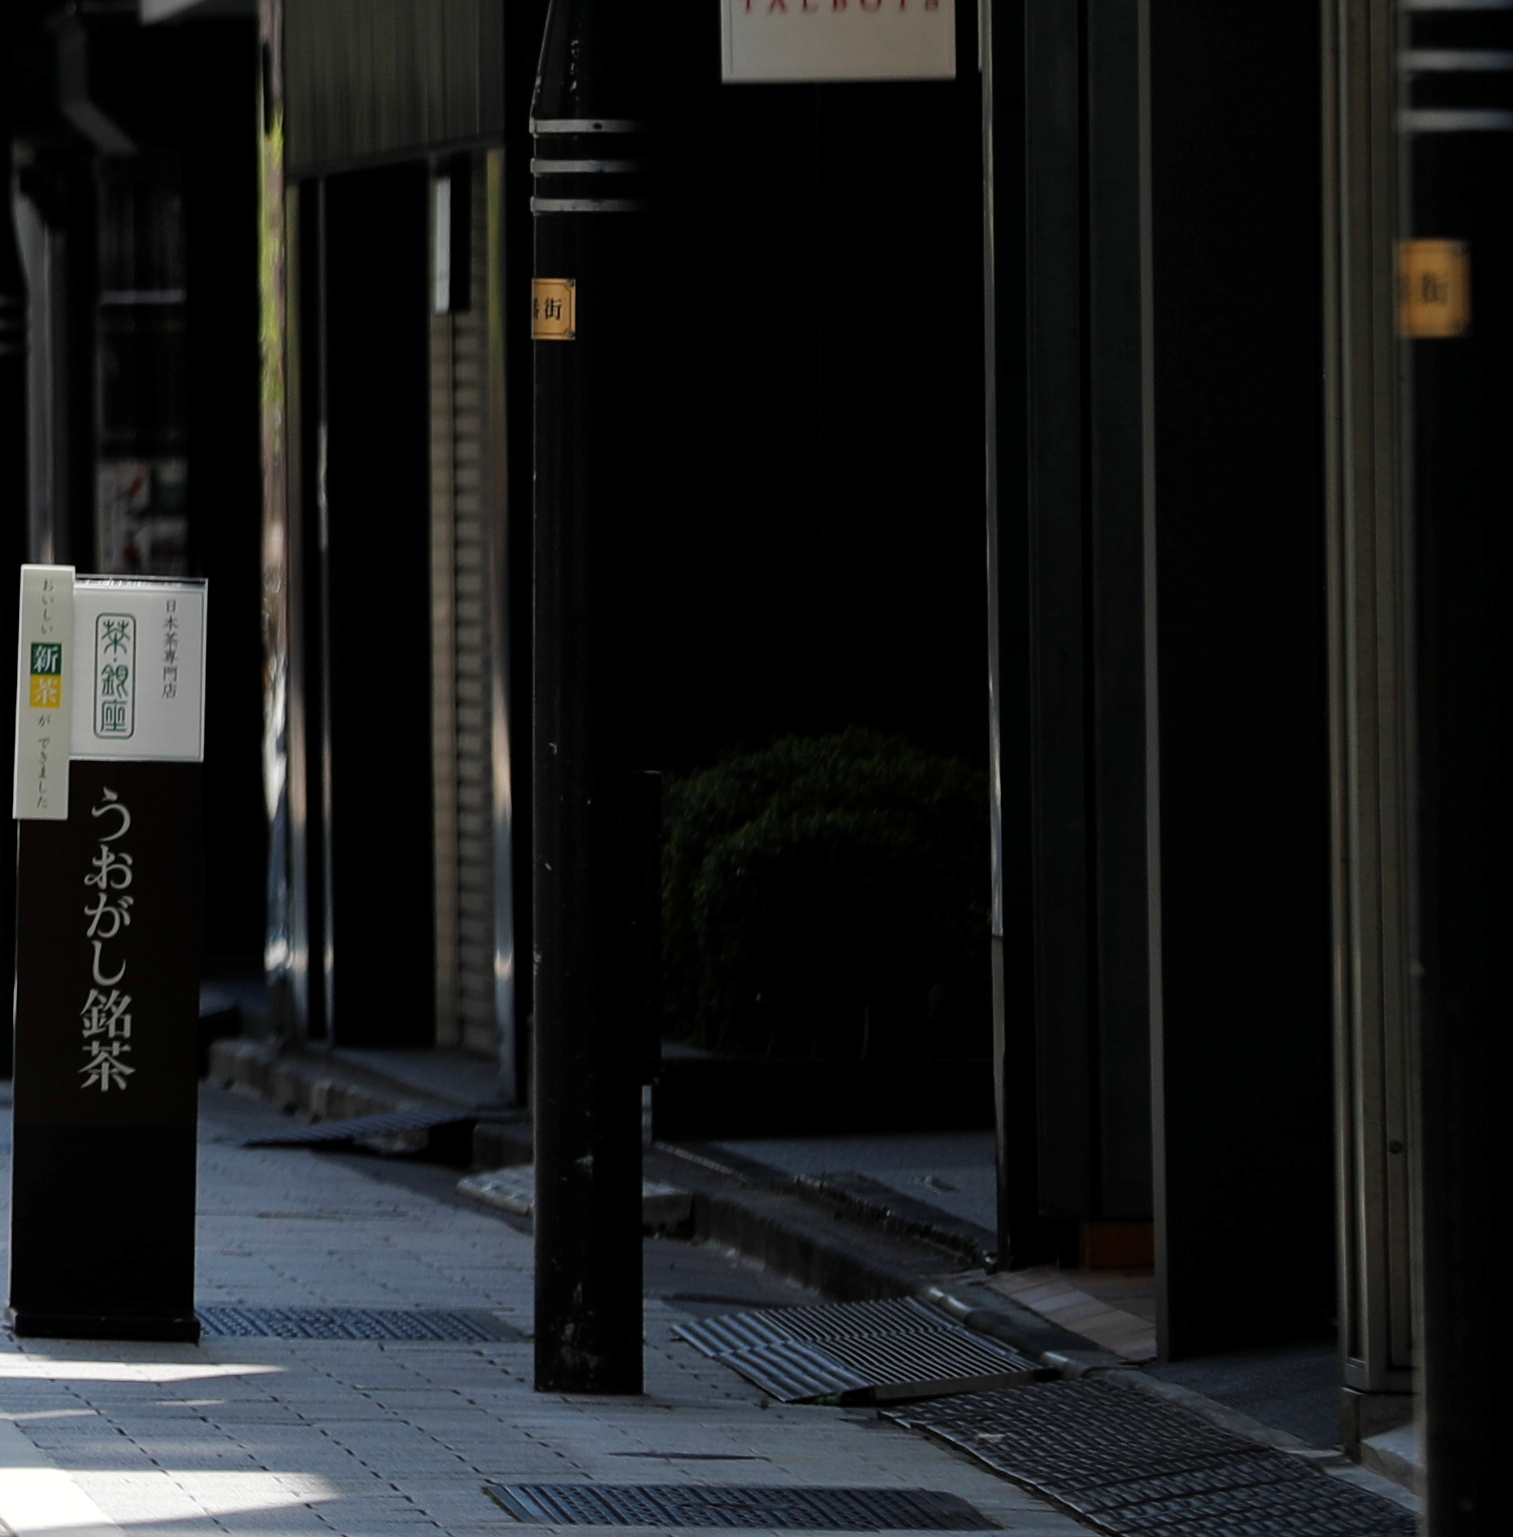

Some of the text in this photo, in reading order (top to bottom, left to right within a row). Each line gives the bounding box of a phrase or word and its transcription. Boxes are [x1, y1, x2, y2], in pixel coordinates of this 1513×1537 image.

[78, 785, 136, 1091] うおがし銘茶
